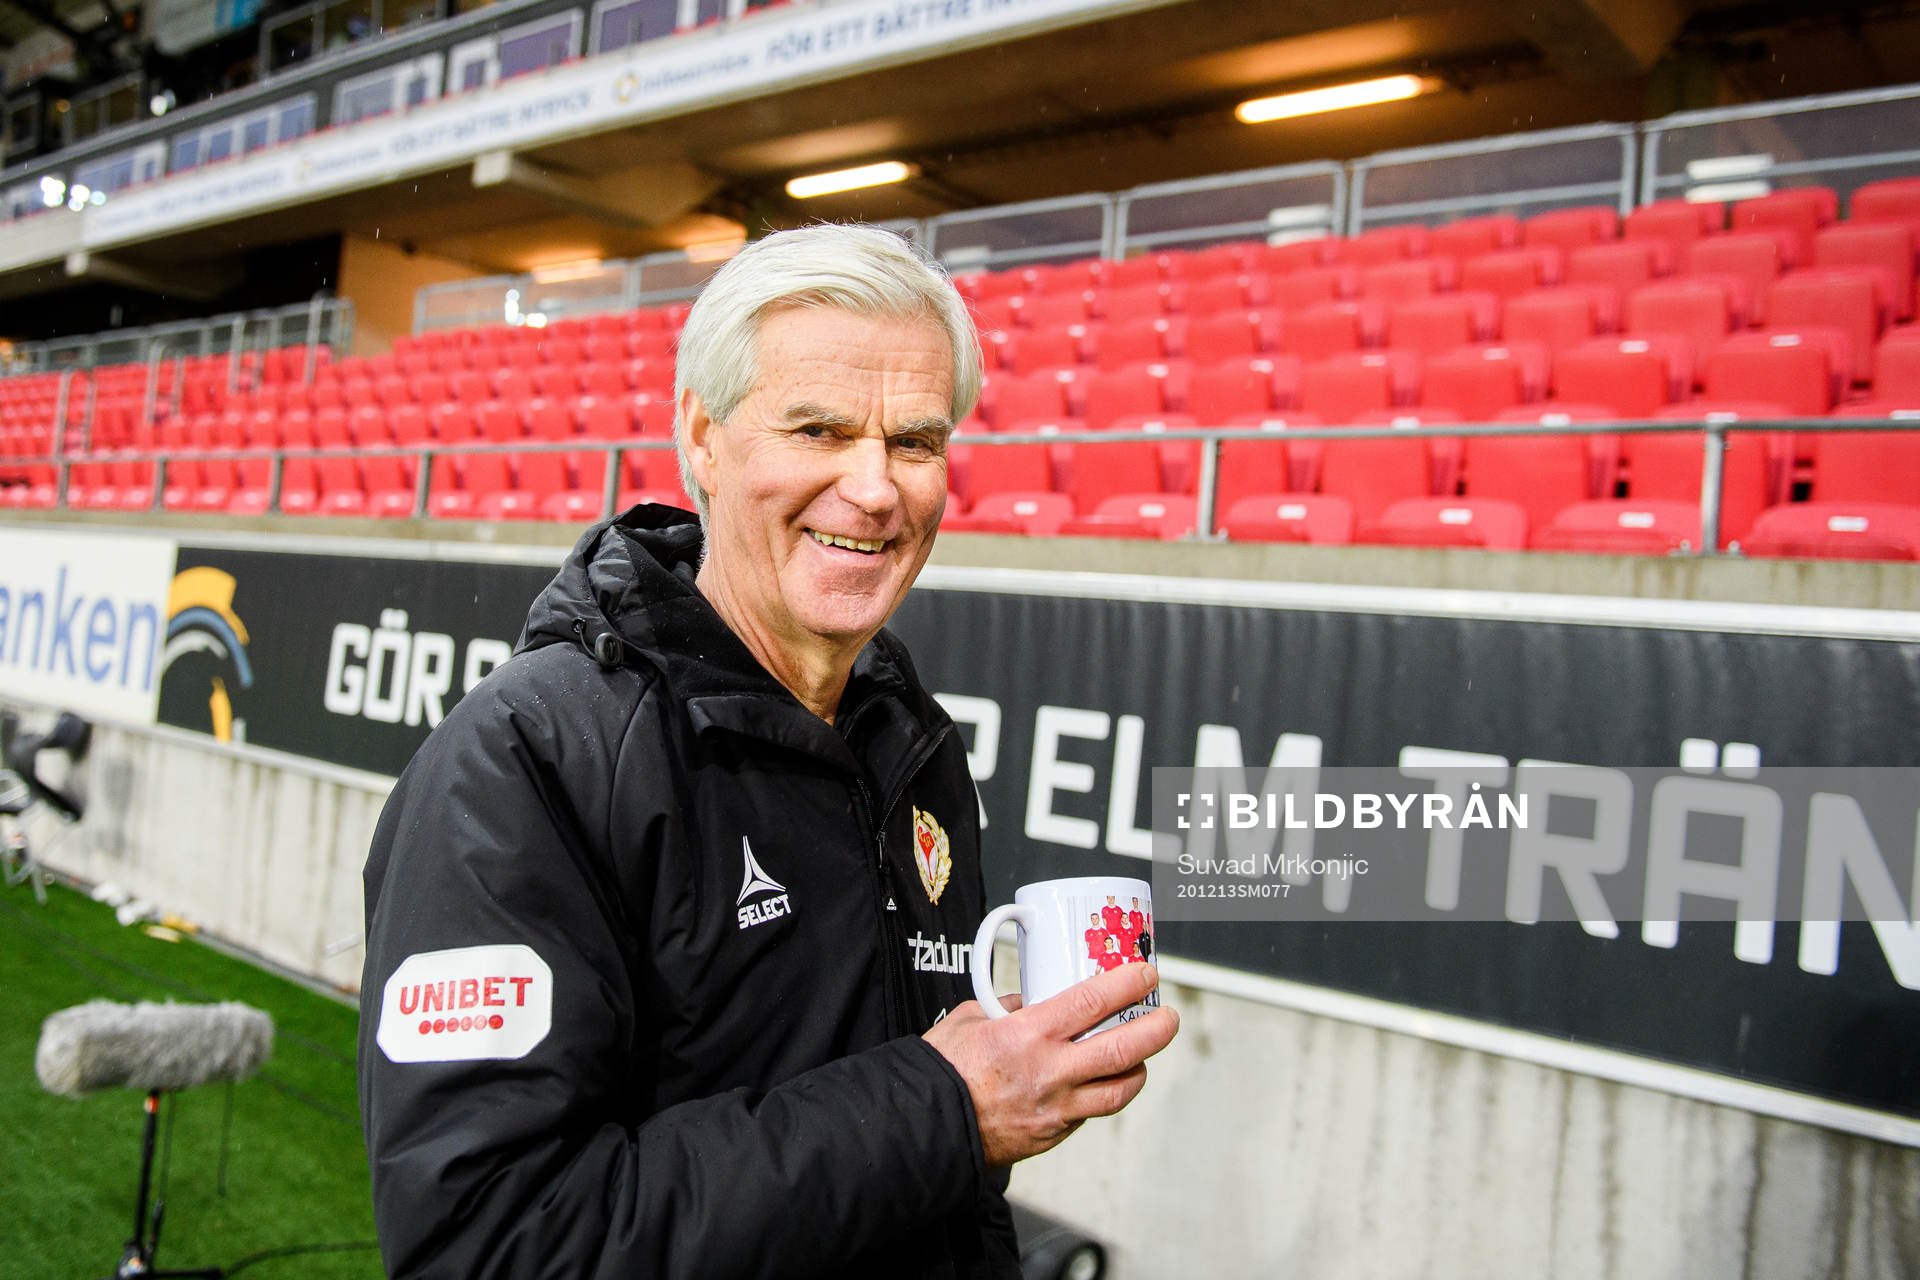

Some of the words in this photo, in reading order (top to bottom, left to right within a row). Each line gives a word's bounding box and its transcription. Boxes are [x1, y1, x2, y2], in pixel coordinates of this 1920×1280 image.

[324, 608, 455, 728] GÖR
[737, 894, 792, 930] SELECT
[400, 977, 533, 1015] UNIBET
